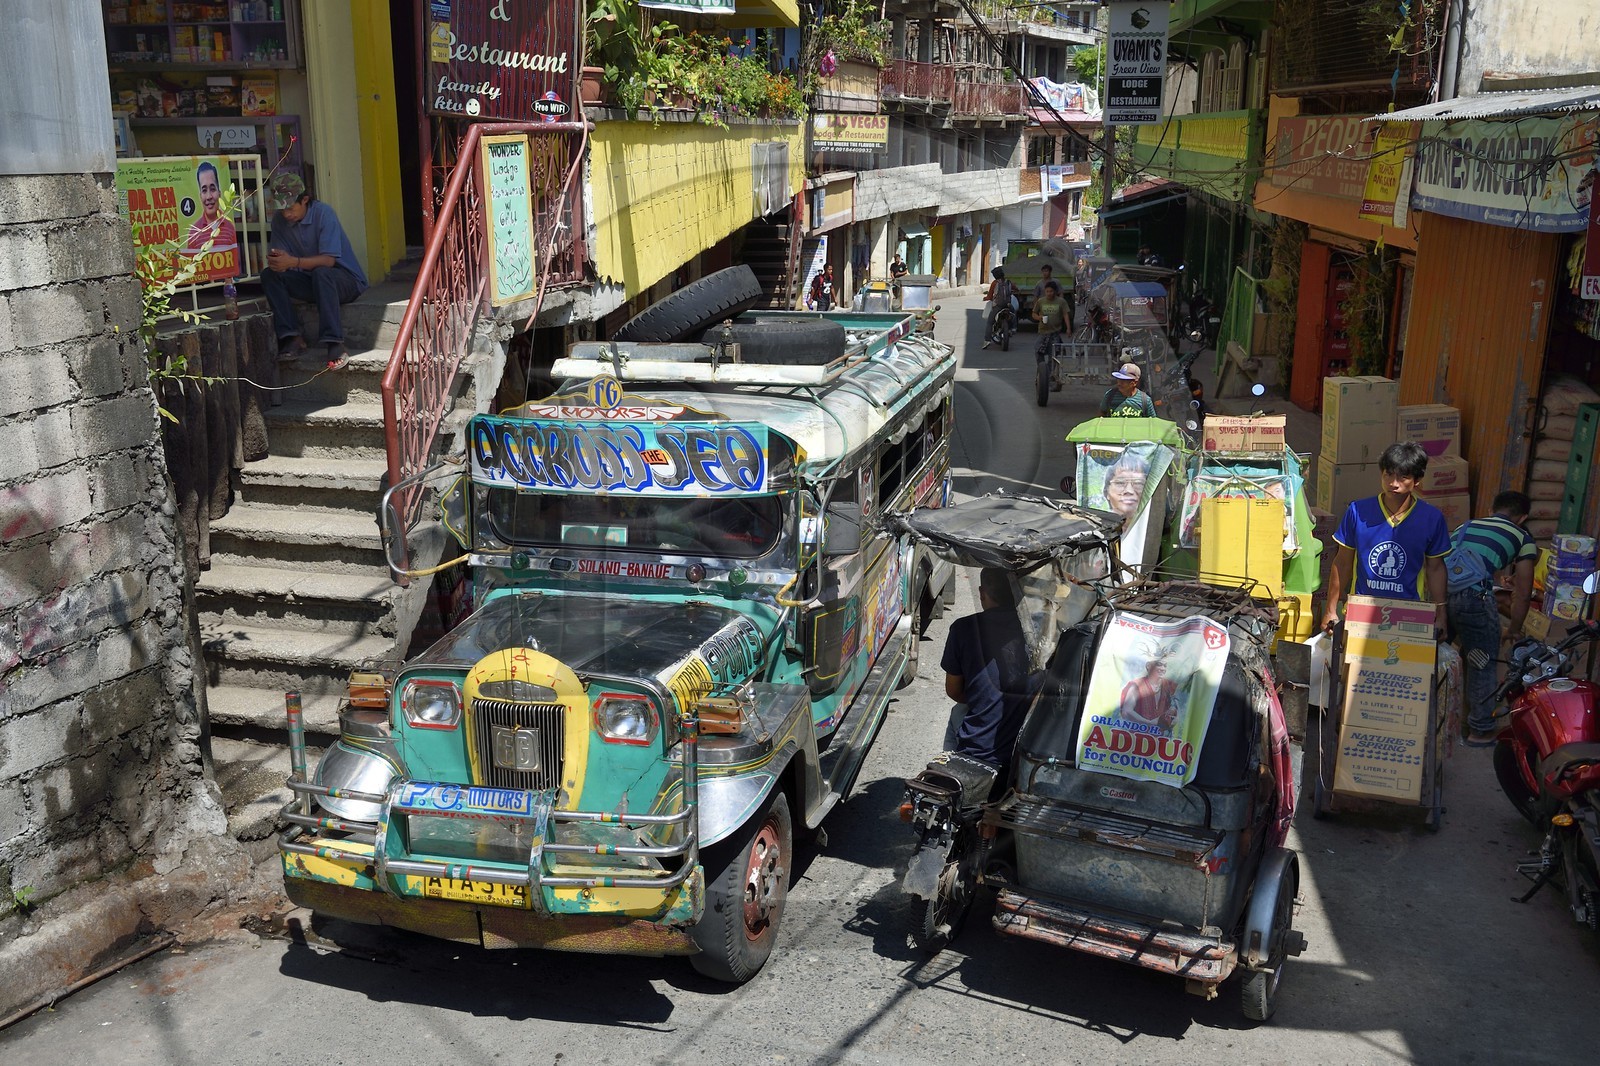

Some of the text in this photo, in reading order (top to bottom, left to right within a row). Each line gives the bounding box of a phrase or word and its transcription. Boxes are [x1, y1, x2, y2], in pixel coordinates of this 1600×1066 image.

[448, 31, 568, 74] Restaurant
[1113, 39, 1162, 62] UYAMI'S
[1112, 62, 1161, 76] Green View
[437, 76, 502, 99] family
[1122, 79, 1148, 88] LODGE
[434, 96, 464, 111] ktv
[534, 102, 565, 113] Free WIFI
[1110, 96, 1158, 106] RESTAURANT
[827, 116, 886, 129] LAS VEGAS
[814, 131, 836, 139] Lodge
[845, 131, 885, 139] Restaurant
[488, 145, 522, 158] WONDER
[492, 160, 518, 181] Lodge
[1292, 160, 1322, 176] LODGE
[1326, 163, 1332, 177] &
[119, 189, 128, 215] KEN
[128, 187, 177, 211] DR. KEN
[183, 199, 191, 214] 4
[129, 209, 178, 226] BAHATAN
[134, 223, 180, 247] ABADOR
[594, 381, 618, 407] FG
[560, 407, 646, 420] MOTORS
[1219, 426, 1238, 435] SILVER
[475, 418, 648, 492] ACCROSS
[640, 450, 664, 463] THE
[578, 559, 673, 579] SOLANO-BANAUE
[1378, 566, 1397, 577] EMB
[1358, 670, 1422, 683] NATURE'S
[1364, 678, 1413, 690] SPRING
[1091, 715, 1162, 736] ORLANDO H.
[1350, 732, 1416, 747] NATURE'S
[1357, 741, 1407, 753] SPRING
[1084, 748, 1107, 762] for
[468, 787, 524, 809] MOTORS
[1109, 788, 1136, 800] Castrol
